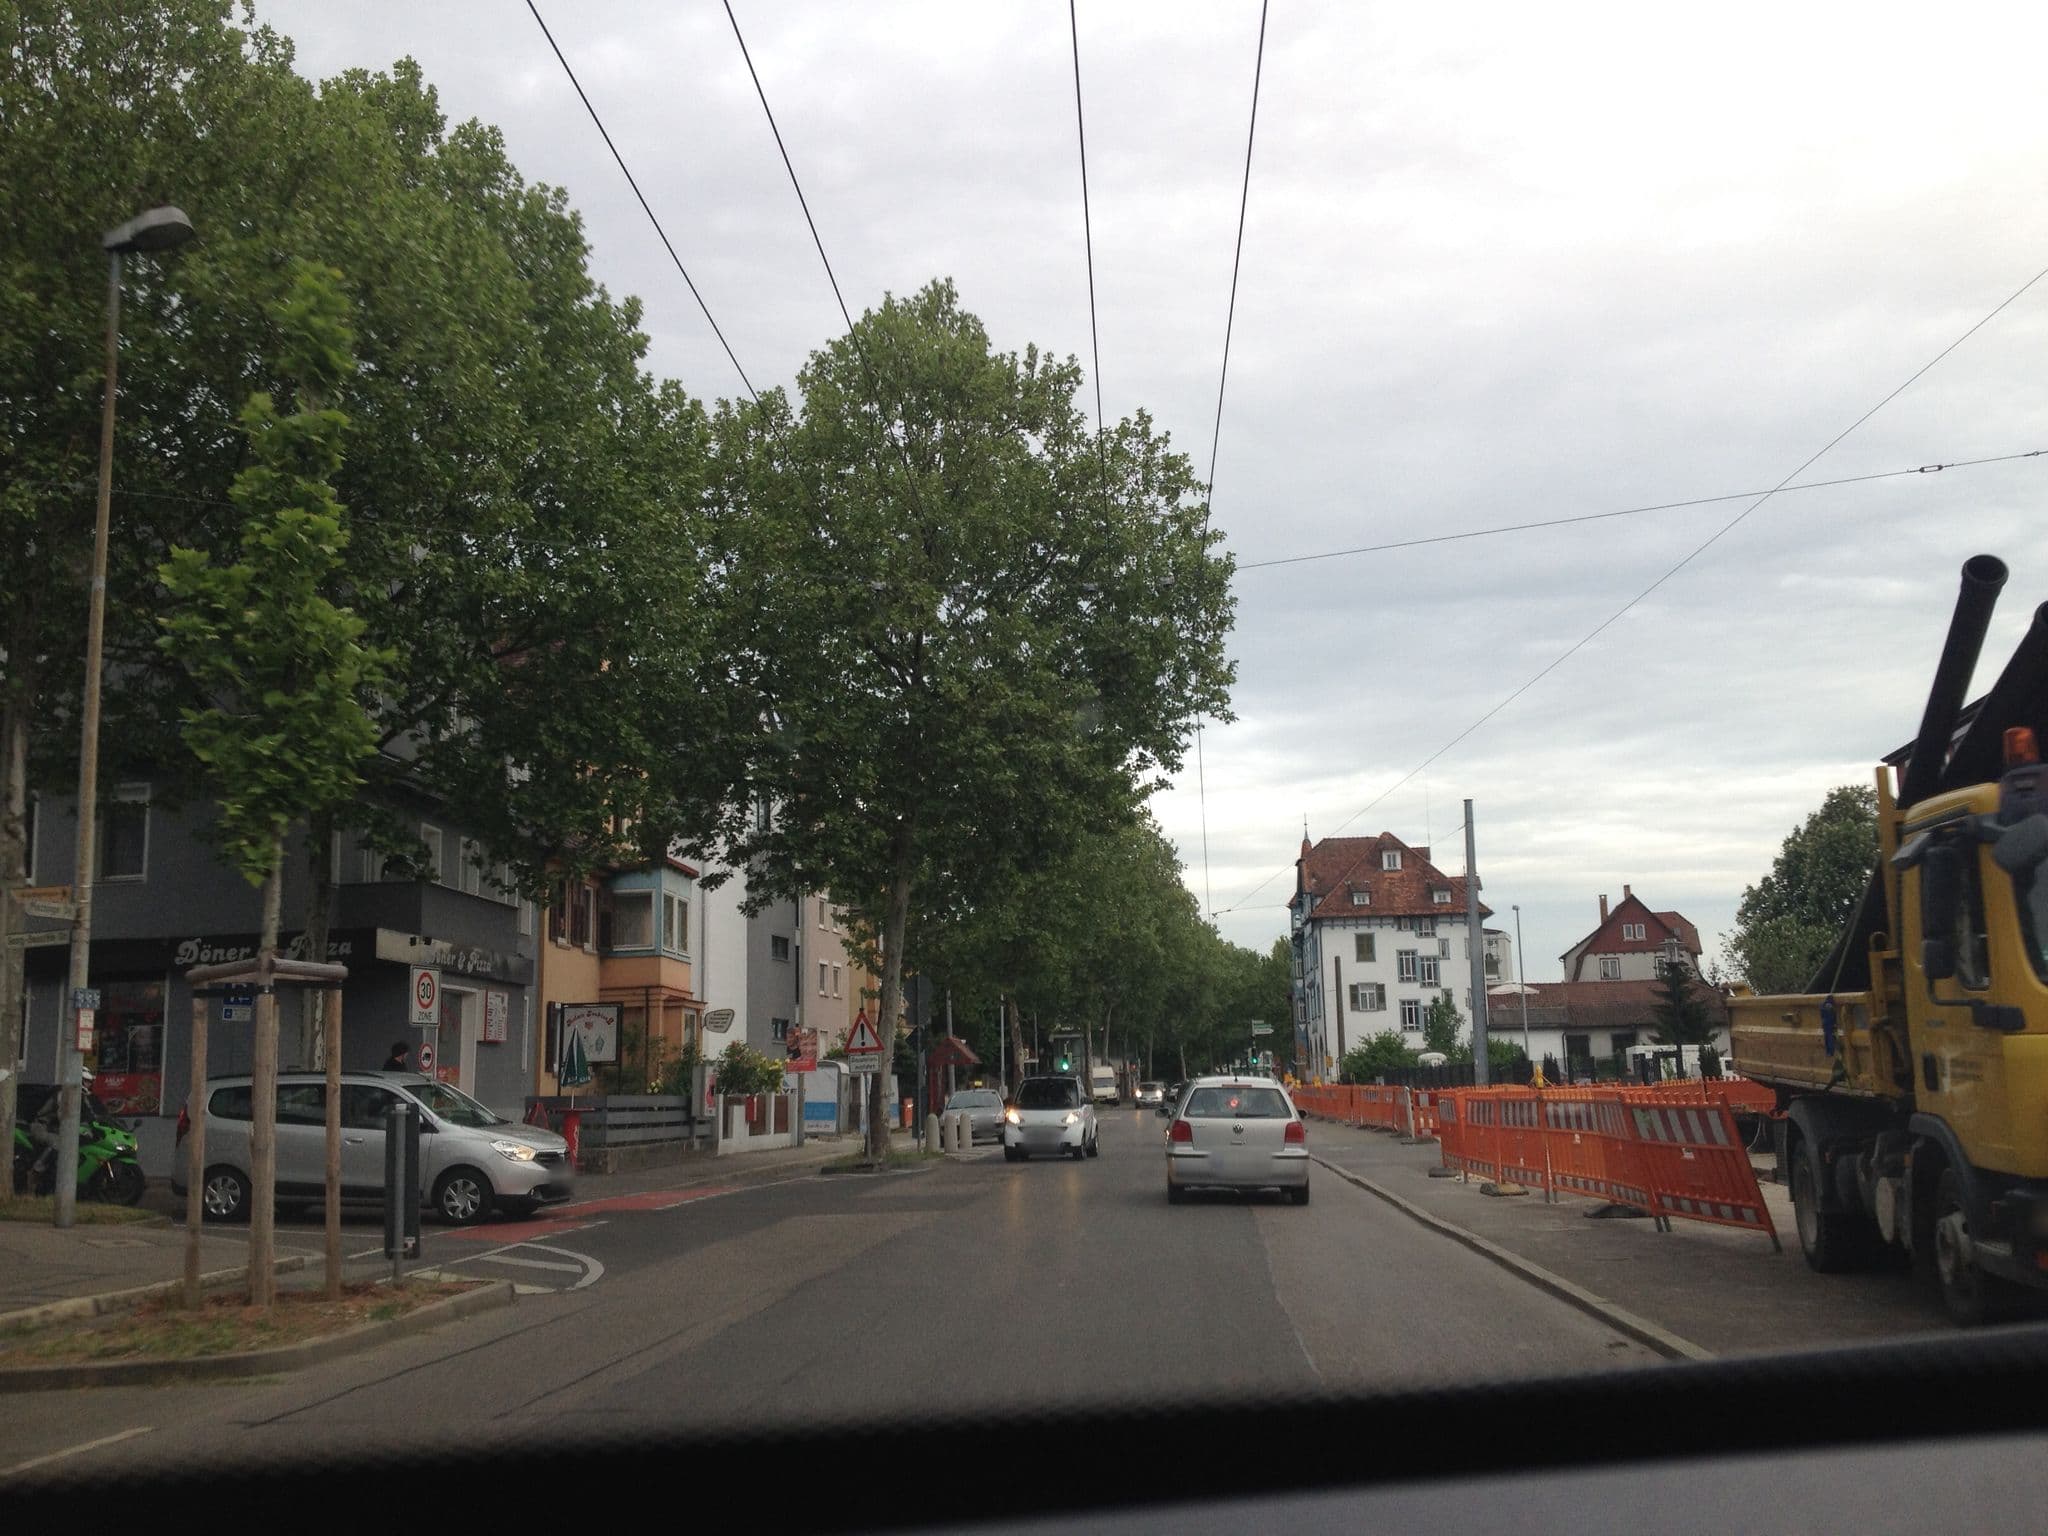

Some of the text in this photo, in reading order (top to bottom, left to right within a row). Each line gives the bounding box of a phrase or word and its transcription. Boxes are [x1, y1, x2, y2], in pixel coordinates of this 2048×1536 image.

[174, 935, 353, 964] Döner Pza
[467, 948, 492, 973] Pizza
[420, 982, 431, 999] 30
[417, 1011, 433, 1021] ZONE
